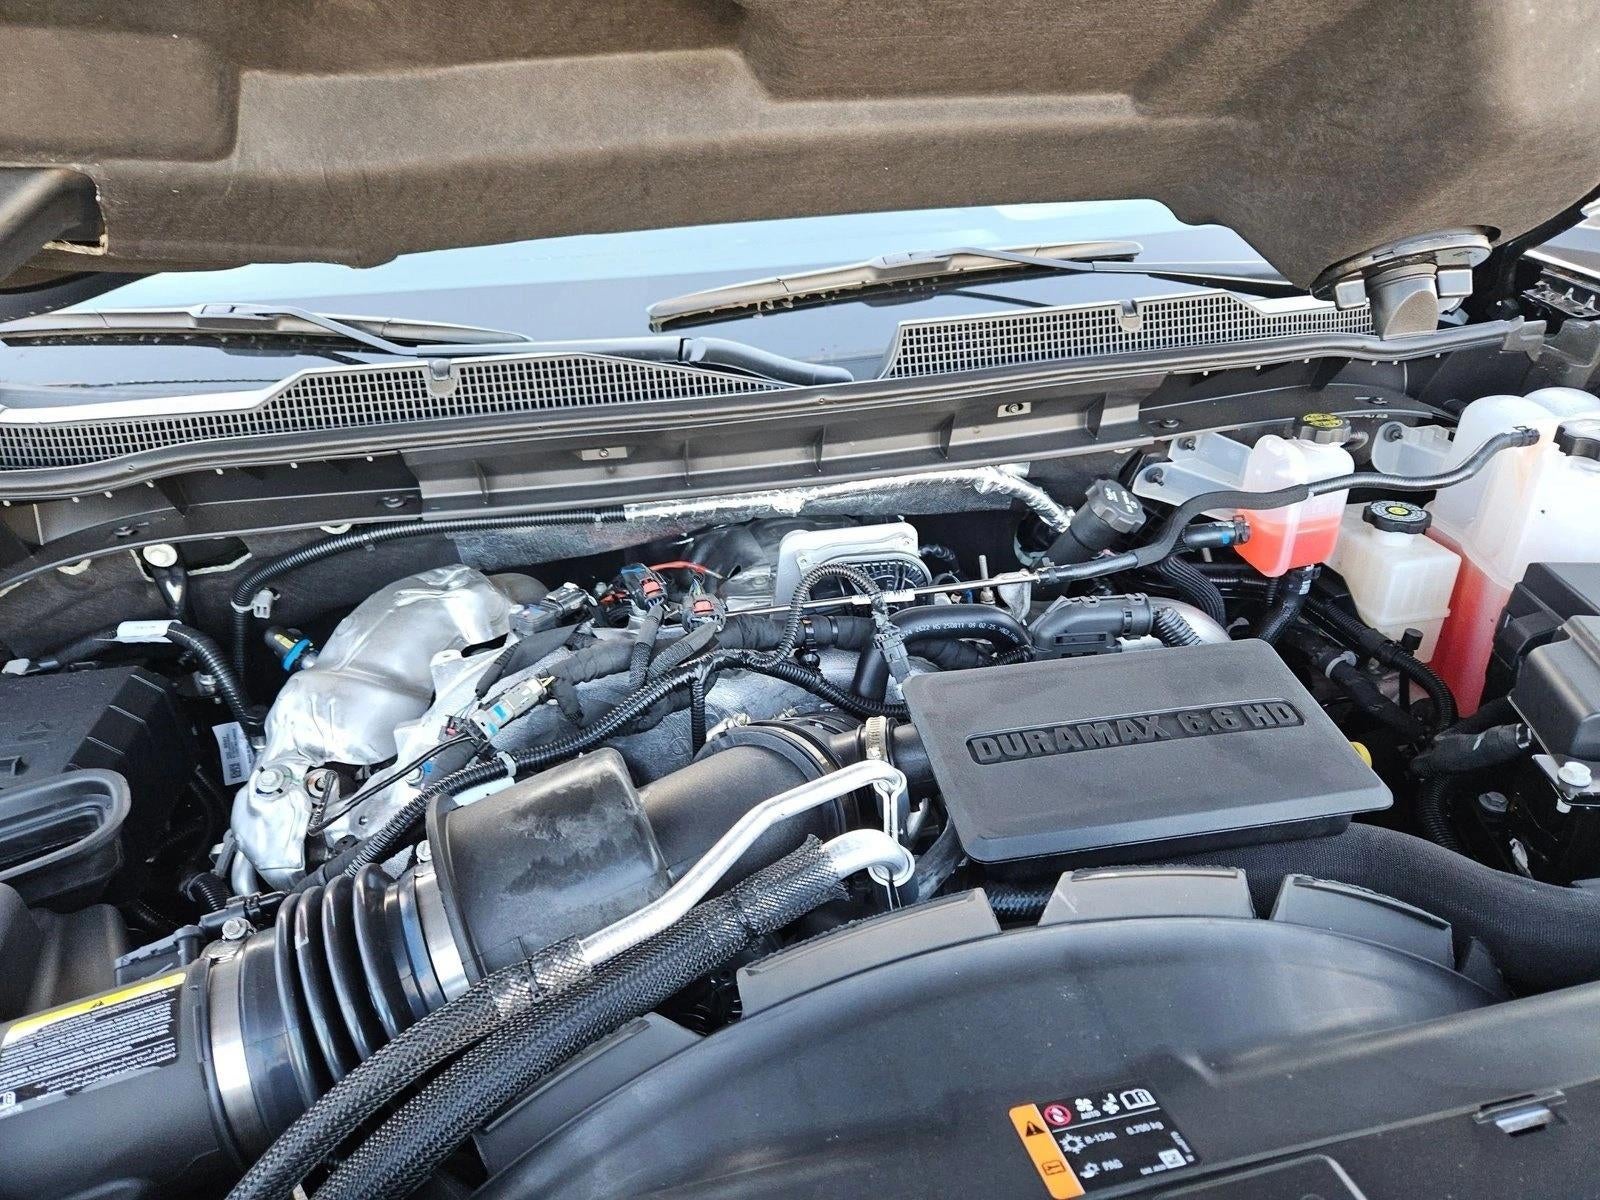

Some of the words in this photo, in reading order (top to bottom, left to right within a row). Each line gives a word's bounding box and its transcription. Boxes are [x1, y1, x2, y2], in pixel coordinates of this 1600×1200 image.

[971, 715, 1171, 763] DURAMAX
[1178, 708, 1243, 734] 6.6
[1244, 702, 1300, 727] HD
